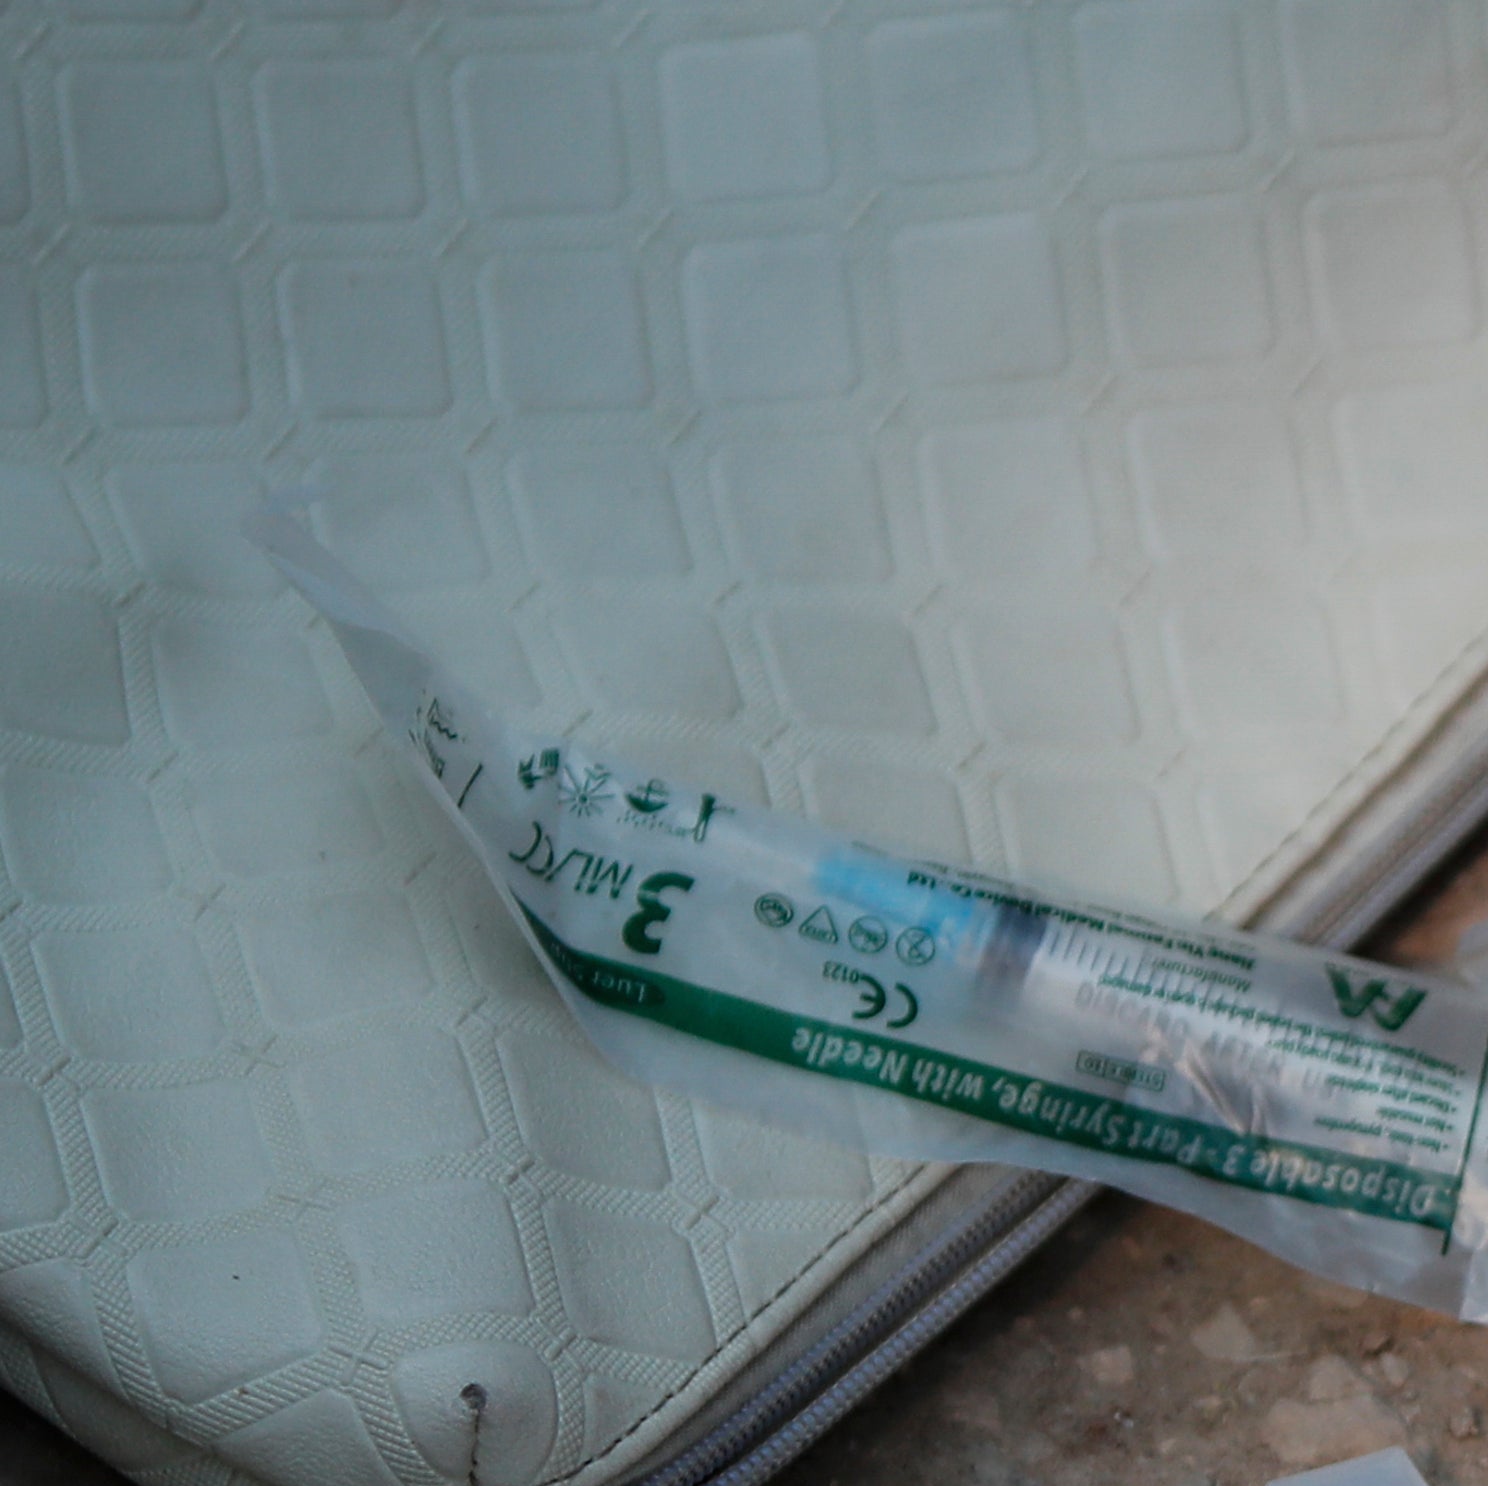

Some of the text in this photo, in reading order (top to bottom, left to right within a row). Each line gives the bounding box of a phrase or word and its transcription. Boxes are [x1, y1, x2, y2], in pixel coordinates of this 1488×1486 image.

[615, 870, 694, 957] 3
[786, 1021, 908, 1085] Needle
[907, 1056, 987, 1108] with
[986, 1071, 1127, 1148] Syringe,
[1222, 1142, 1246, 1173] 3
[1246, 1140, 1436, 1219] Disposable
